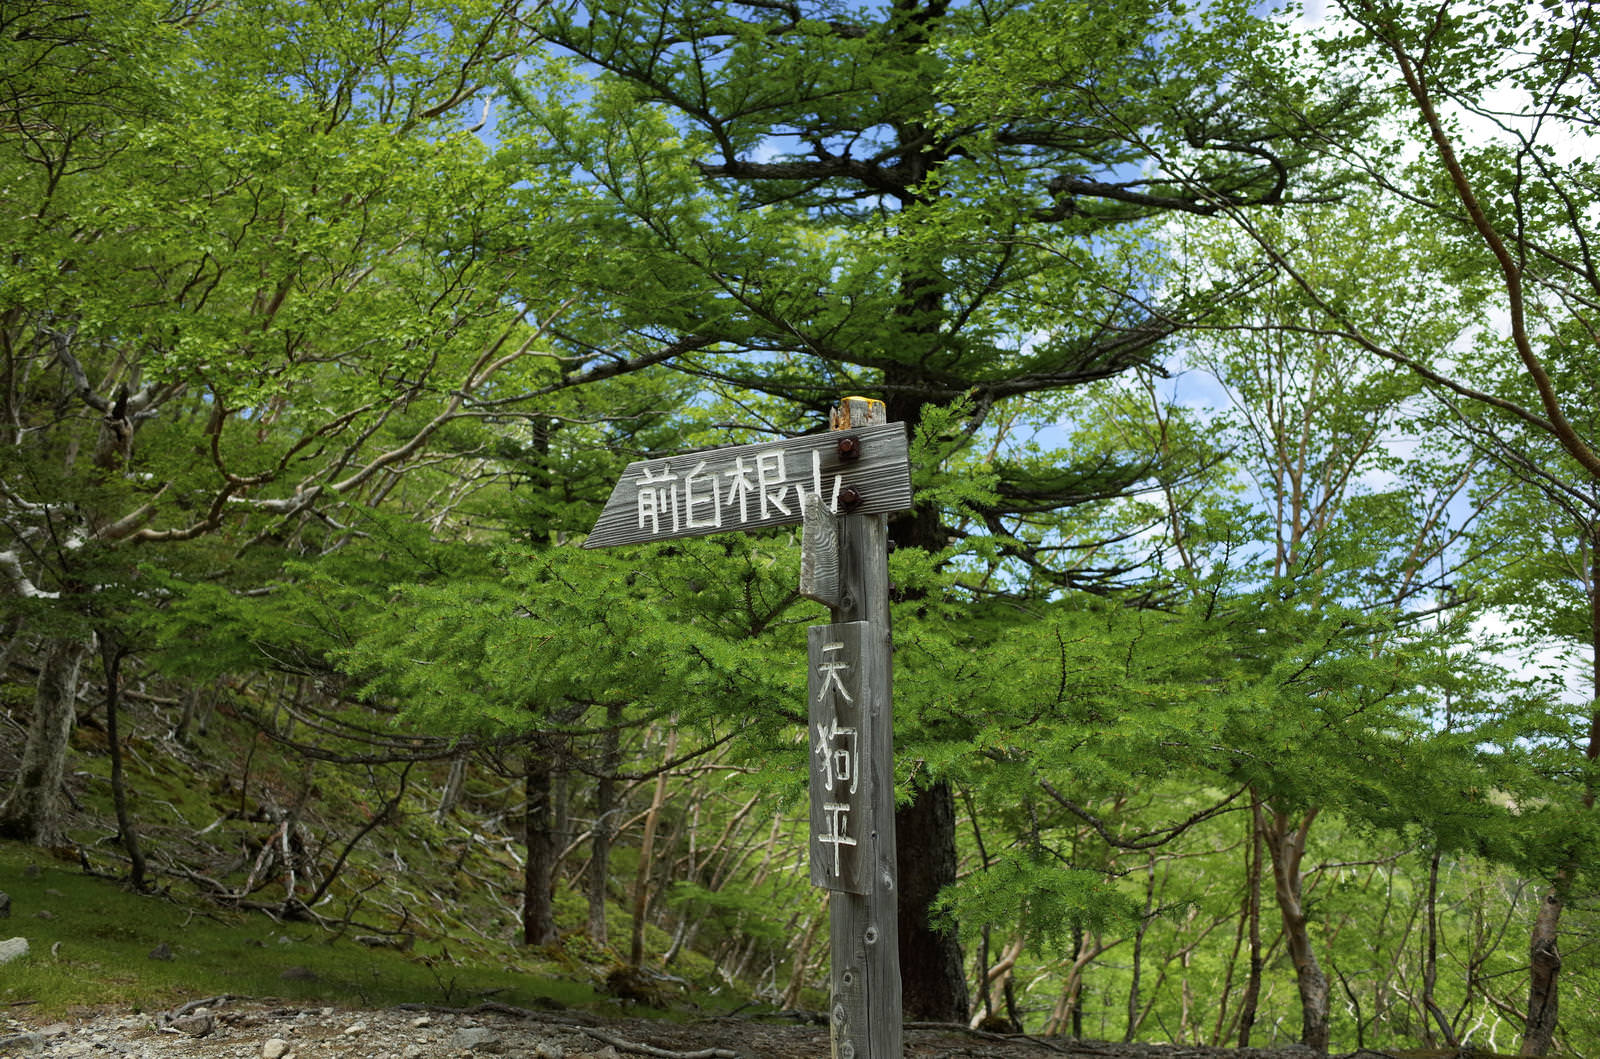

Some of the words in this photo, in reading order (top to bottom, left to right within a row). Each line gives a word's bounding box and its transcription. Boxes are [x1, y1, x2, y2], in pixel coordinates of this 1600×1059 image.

[636, 450, 841, 533] 前白根山
[815, 642, 857, 877] 天狗平
